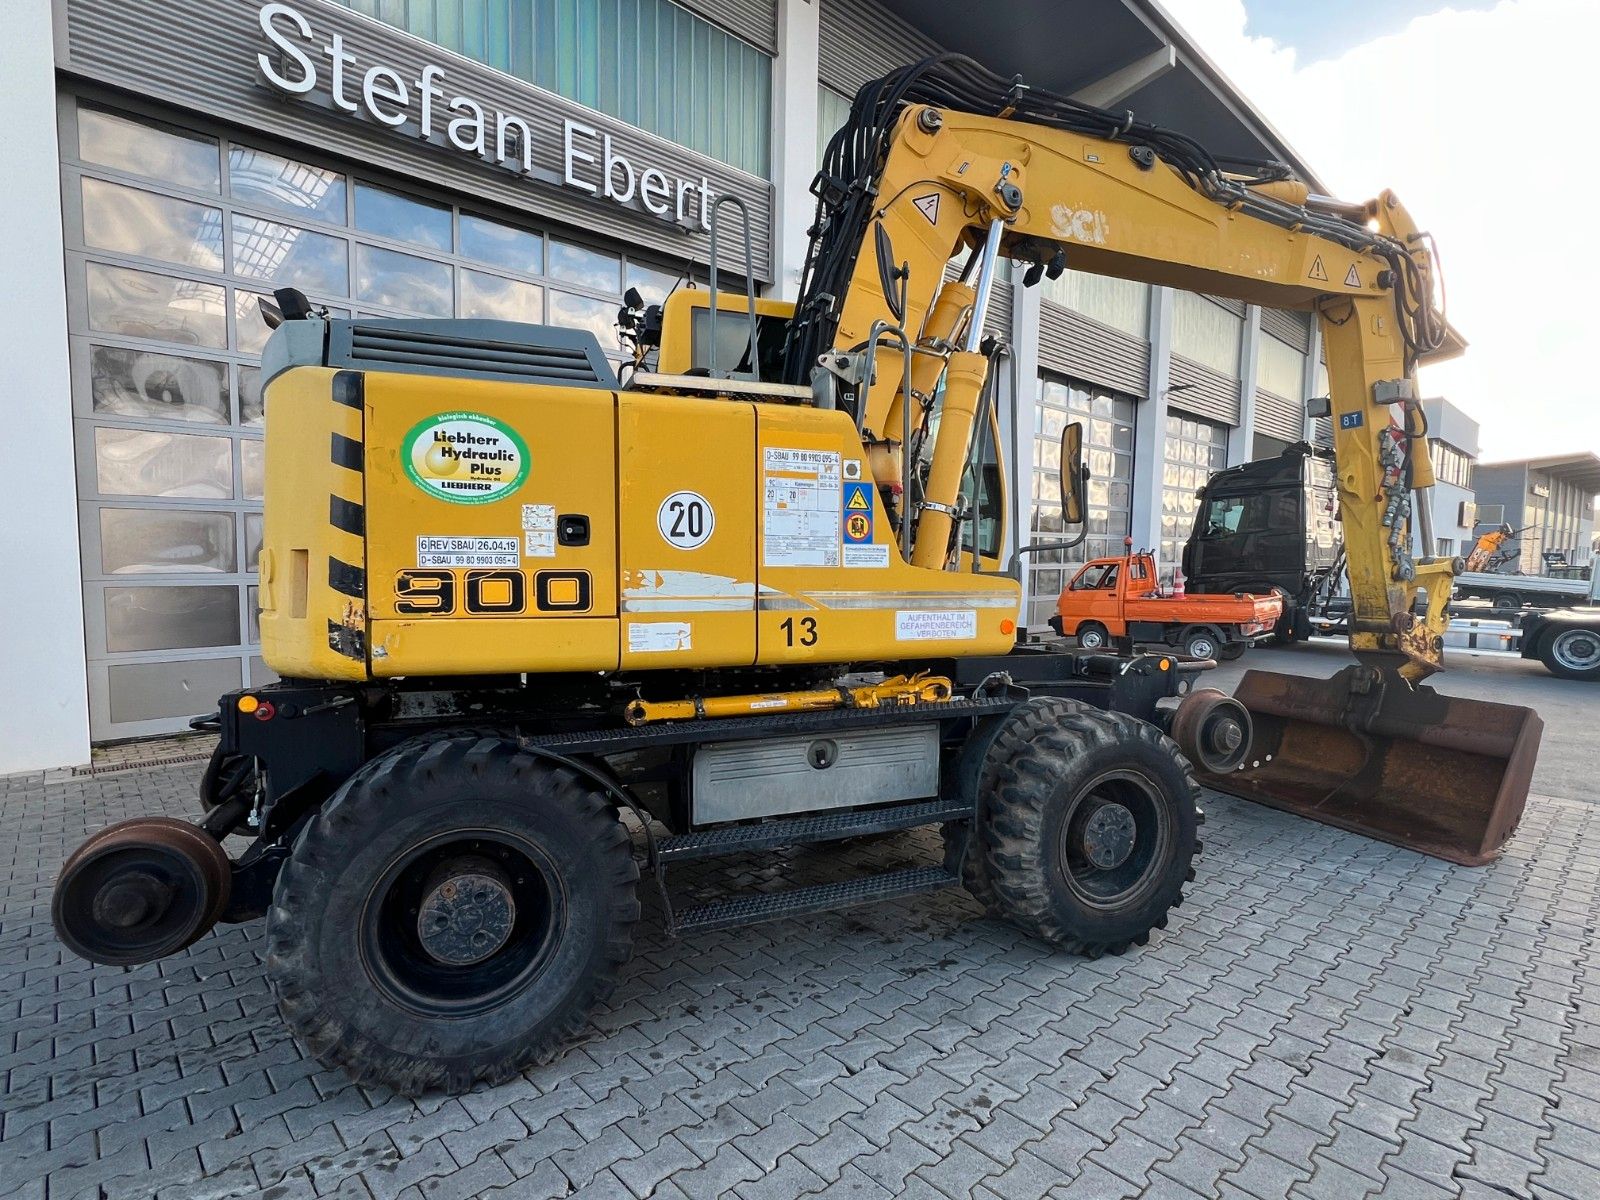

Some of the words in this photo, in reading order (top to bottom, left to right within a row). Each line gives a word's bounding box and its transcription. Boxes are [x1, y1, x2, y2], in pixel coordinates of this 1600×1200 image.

[256, 3, 533, 173] Stefan
[561, 118, 716, 234] Ebert
[1343, 415, 1350, 426] 8
[1351, 413, 1358, 425] T
[433, 430, 499, 445] Liebherr
[441, 447, 514, 461] Hydraulic
[766, 450, 789, 461] D-SBAU
[792, 452, 800, 462] 99
[470, 463, 502, 475] Plus
[441, 481, 492, 491] LIEBHERR
[669, 501, 703, 538] 20
[420, 540, 427, 549] 6
[430, 540, 448, 550] REV
[451, 540, 475, 550] SBAU
[477, 541, 516, 551] 26.04.19
[421, 555, 452, 565] D-SBAU
[455, 556, 464, 565] 99
[466, 556, 475, 565] 80
[476, 556, 493, 565] 9903
[494, 556, 516, 565] 095-4
[394, 568, 593, 616] 900
[908, 614, 955, 622] AUFENTHALT
[956, 613, 966, 621] IM
[780, 616, 818, 647] 13
[900, 621, 973, 630] GEFAHRENBEREICH
